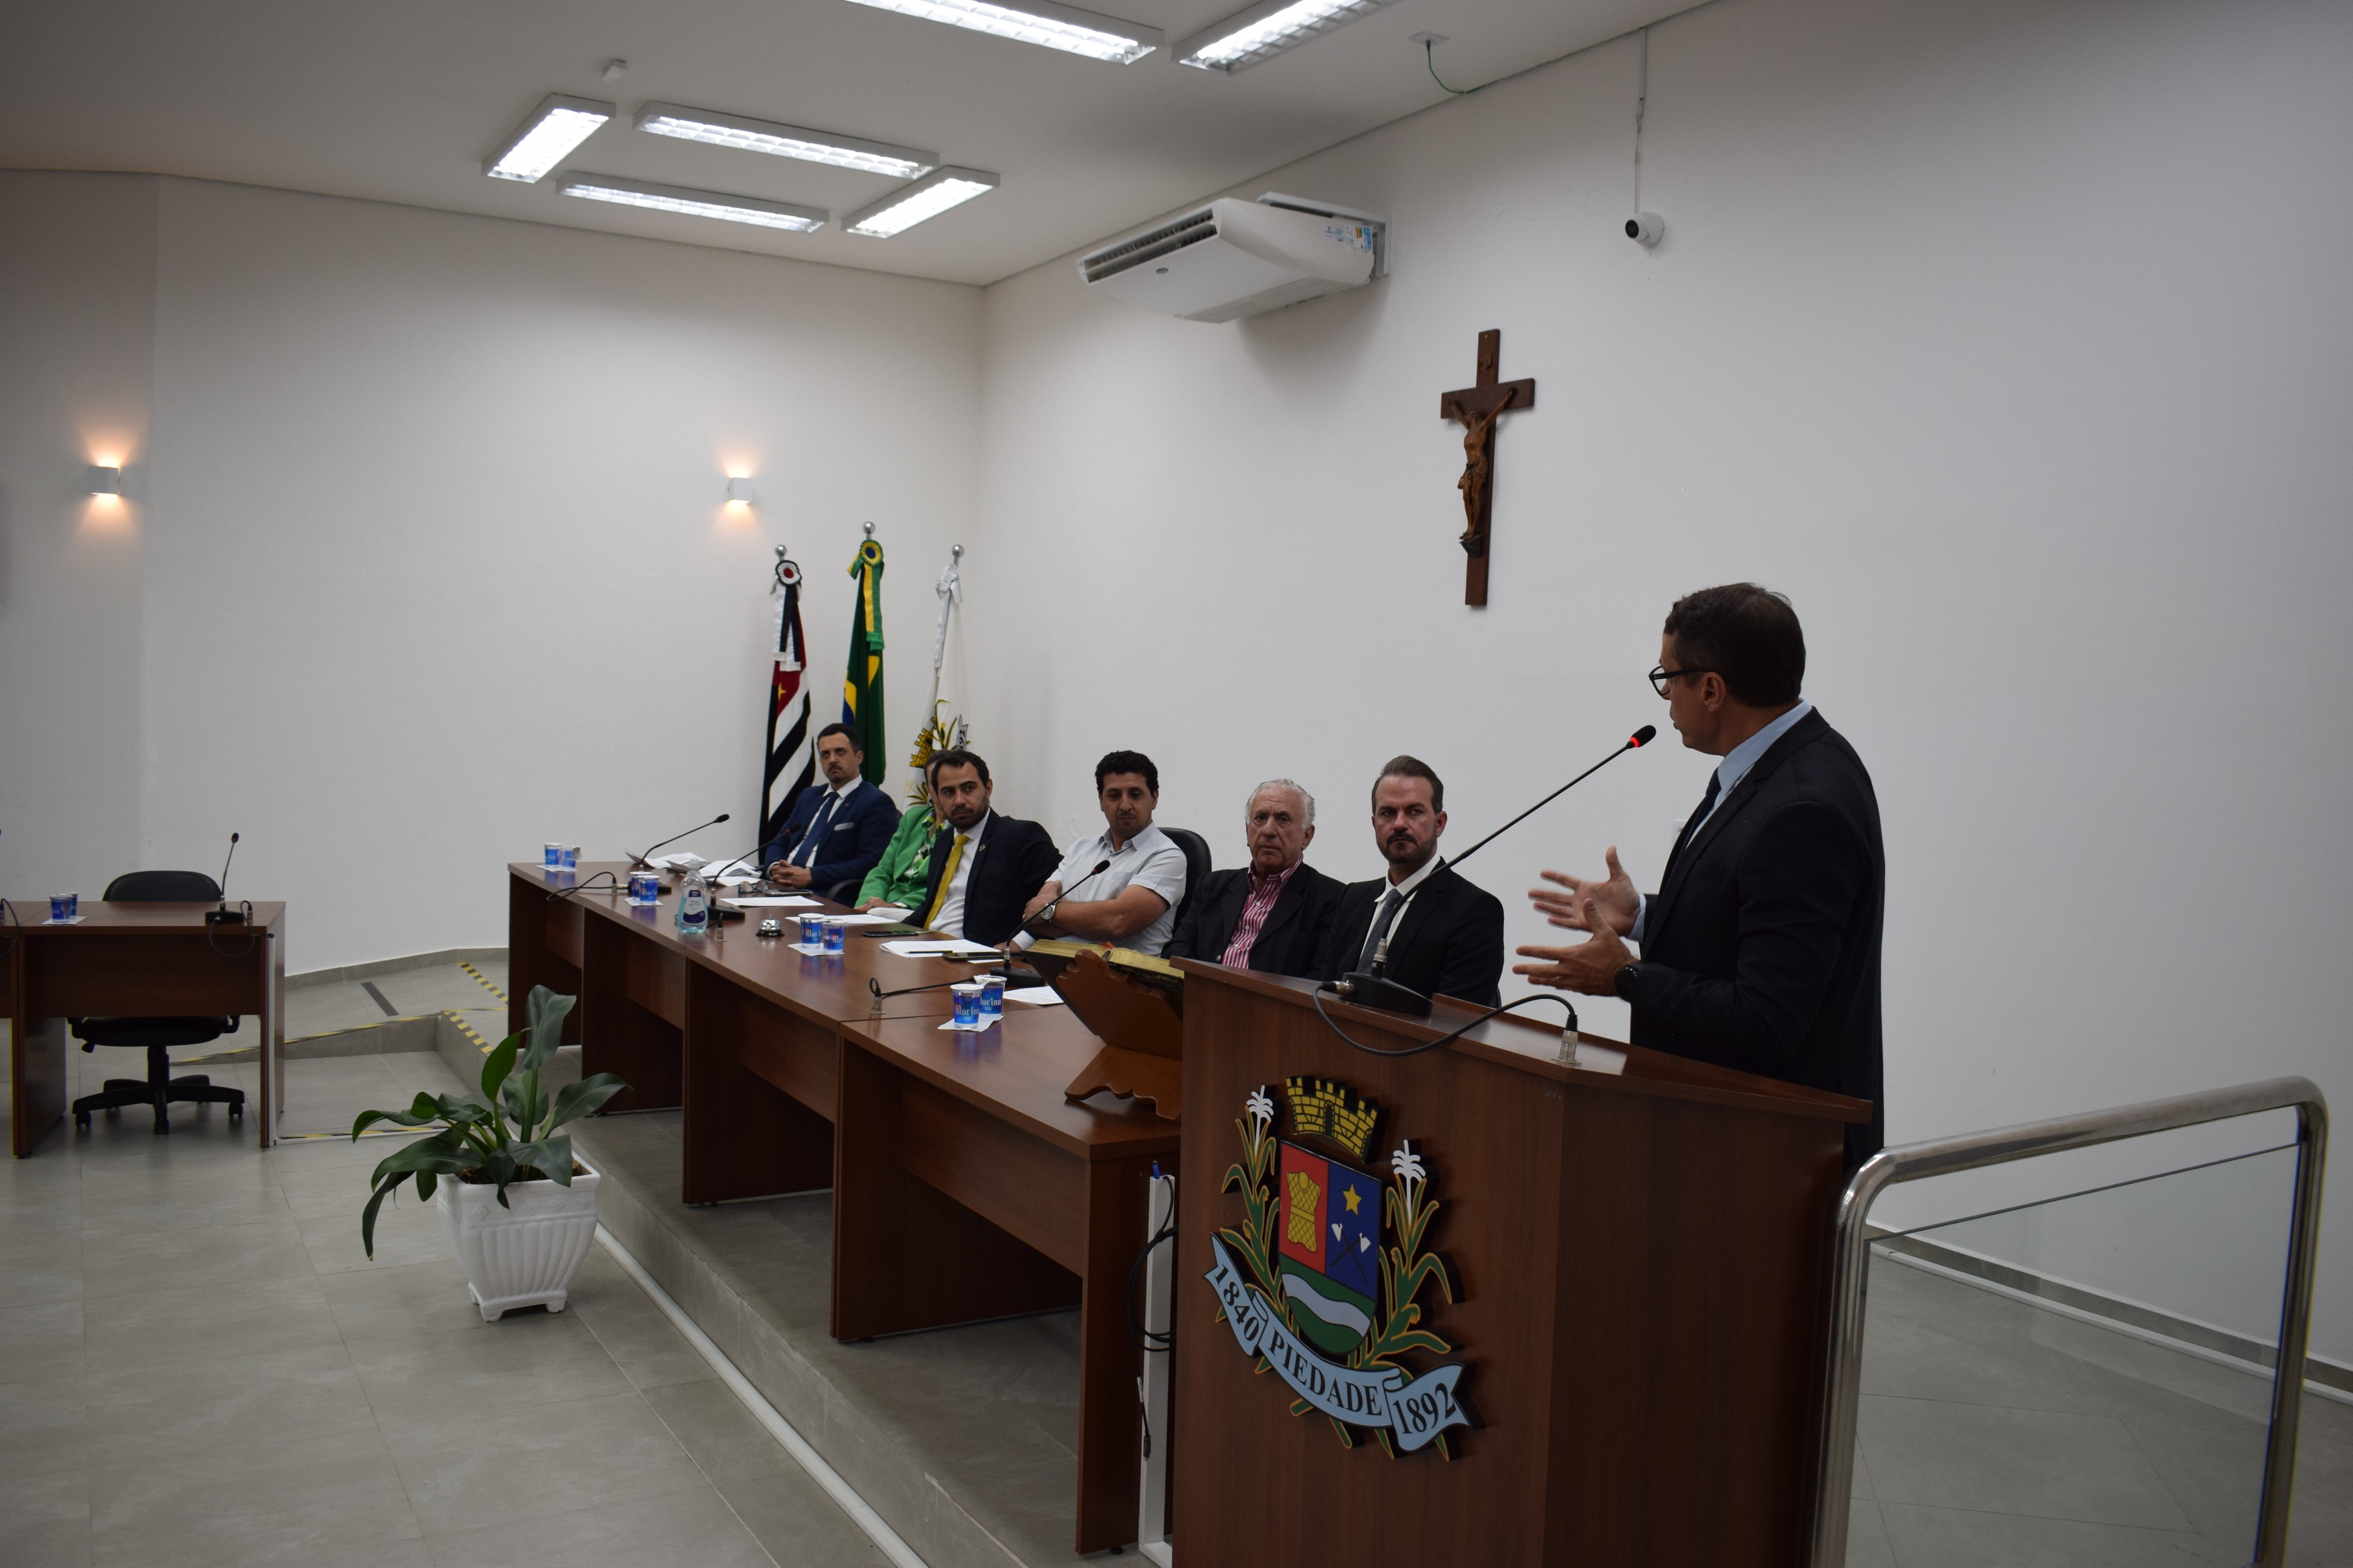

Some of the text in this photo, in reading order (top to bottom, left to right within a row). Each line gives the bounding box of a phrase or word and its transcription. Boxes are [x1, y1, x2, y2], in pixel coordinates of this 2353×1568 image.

[980, 996, 1001, 1006] larina
[1214, 1264, 1457, 1434] 1840 PIEDADE 1892
